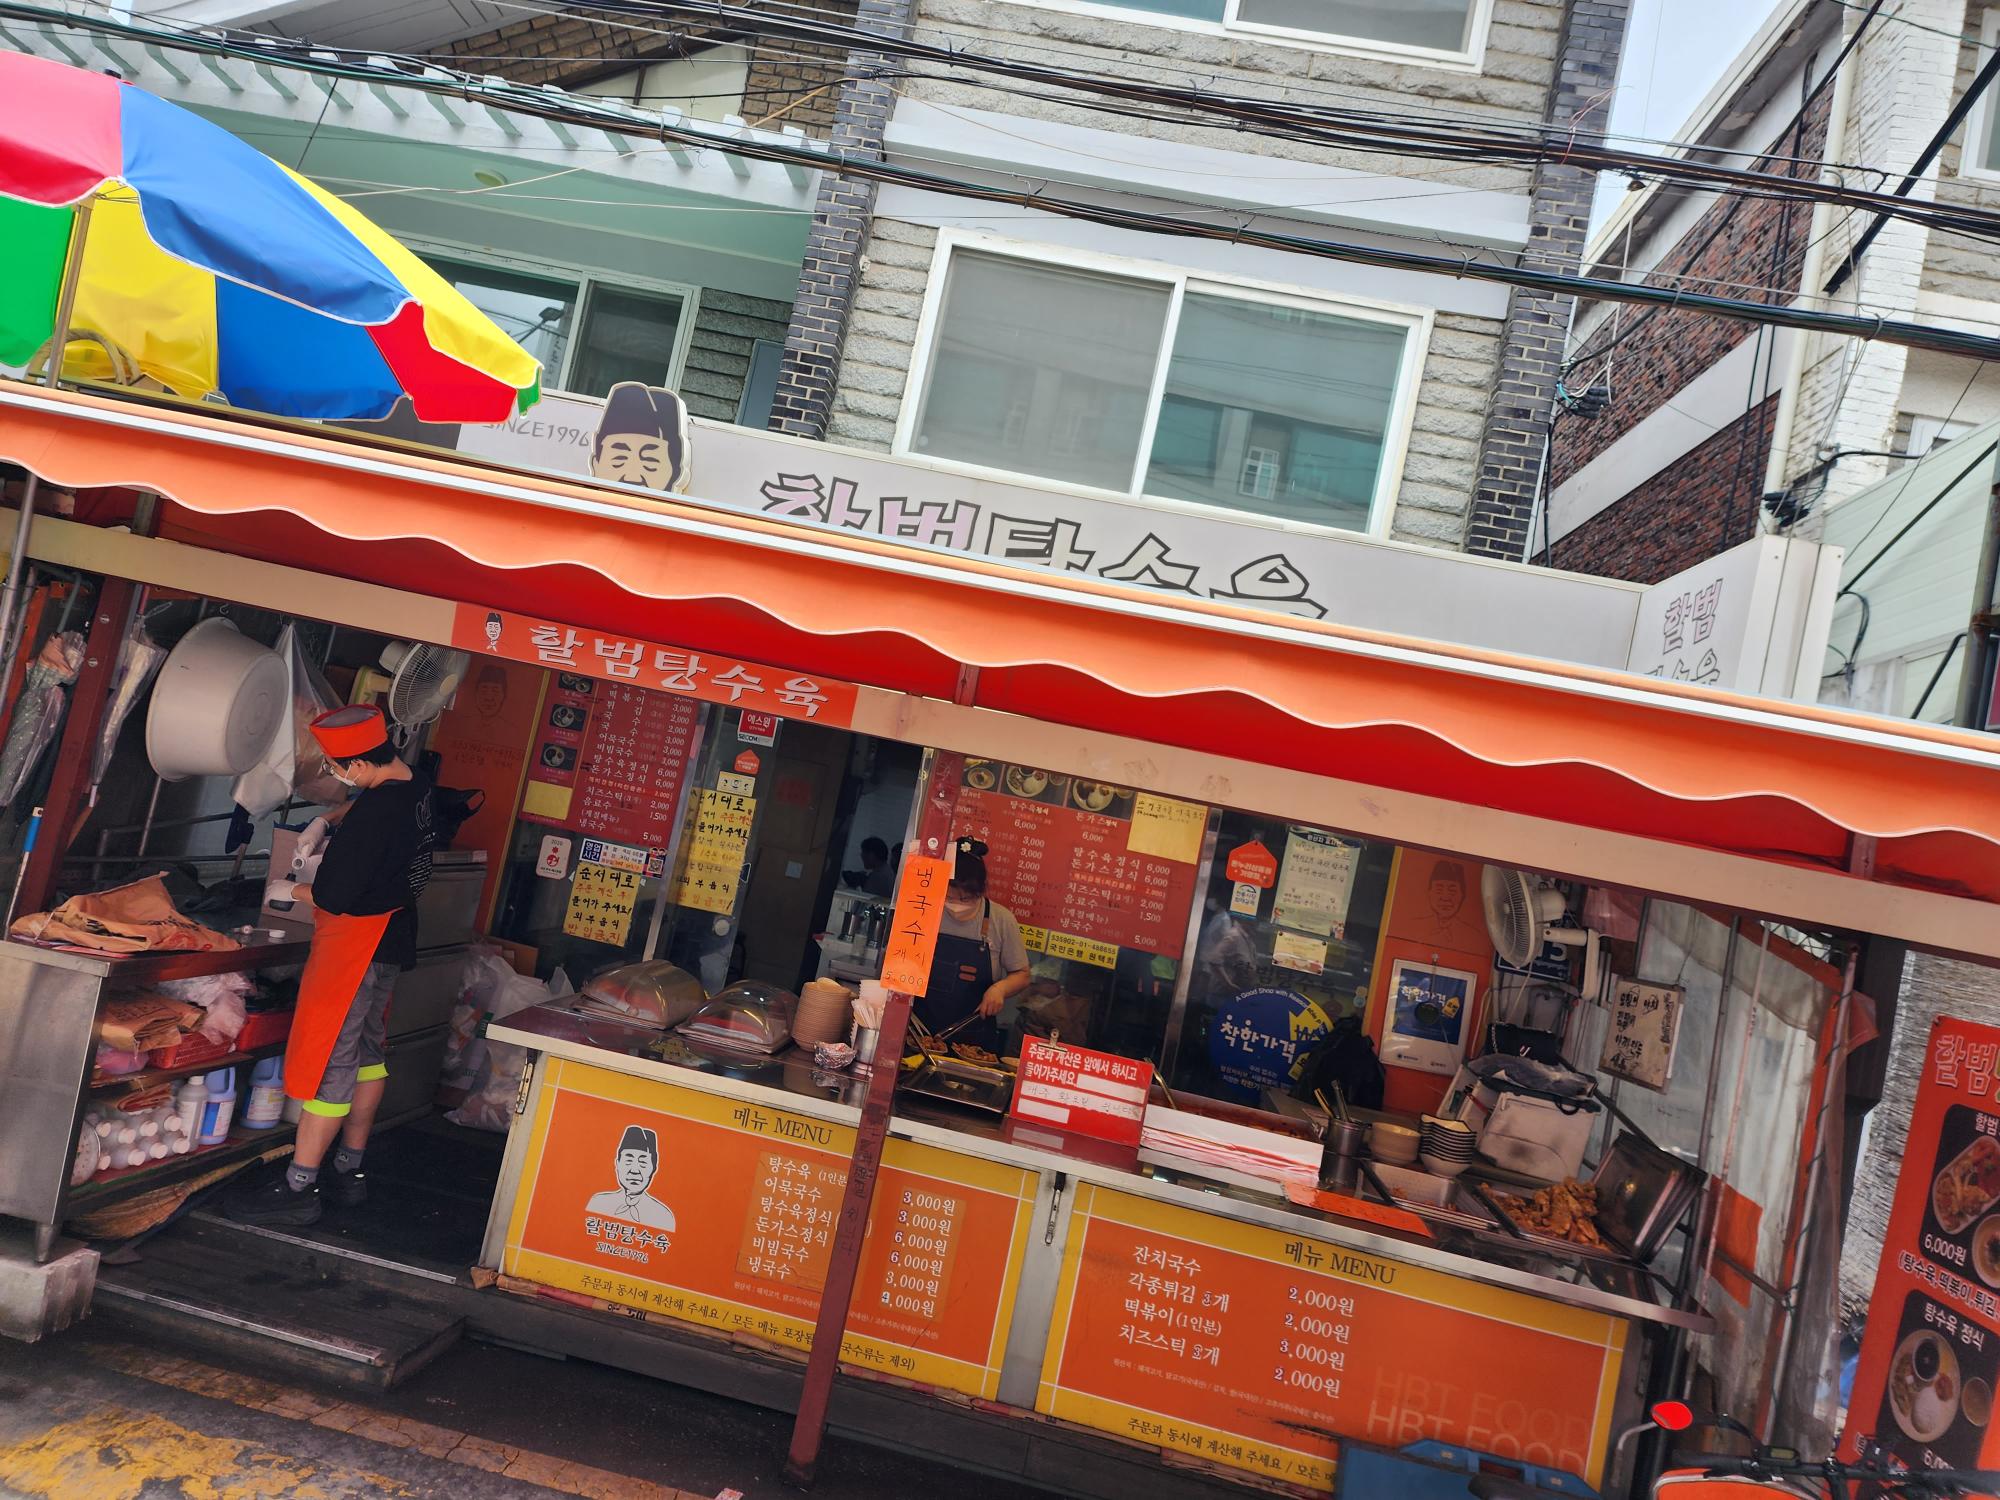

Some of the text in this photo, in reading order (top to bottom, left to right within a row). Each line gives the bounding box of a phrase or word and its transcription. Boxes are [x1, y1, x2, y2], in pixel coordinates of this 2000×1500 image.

[1662, 577, 1724, 655] 할범
[530, 625, 829, 718] 할범탕수육
[746, 712, 772, 729] 에스원
[585, 841, 602, 853] 영업
[1014, 819, 1037, 832] 6,000
[1082, 830, 1105, 843] 6,000
[1023, 836, 1046, 848] 3,000
[582, 850, 601, 862] 시간
[1020, 847, 1043, 860] 3,000
[1146, 863, 1170, 876] 6,000
[579, 867, 635, 889] 순서대로
[1144, 875, 1168, 888] 6,000
[900, 866, 933, 946] 냉국수
[1140, 898, 1164, 911] 2,000
[1059, 915, 1094, 931] 냉국수
[1220, 1013, 1297, 1065] 착한가격
[1027, 1042, 1054, 1062] 주문과
[1084, 1056, 1110, 1076] 앞에서
[1111, 1062, 1138, 1081] 하시고
[733, 1107, 833, 1145] 메뉴 MENU
[769, 1157, 812, 1181] 탕수육
[764, 1176, 822, 1203] 어묵국수
[585, 1215, 673, 1254] 할범탕수육
[755, 1215, 828, 1248] 돈가스정식
[752, 1236, 810, 1264] 비빔국수
[1131, 1245, 1202, 1277] 잔치국수
[1284, 1240, 1397, 1284] 메뉴 MENU
[1923, 1232, 1968, 1268] 6,000원
[747, 1255, 791, 1281] 냉국수
[1127, 1271, 1196, 1304] 각종튀김
[580, 1274, 614, 1293] 주문과
[615, 1283, 649, 1302] 동시에
[652, 1292, 685, 1311] 계산해
[687, 1302, 720, 1320] 주세요
[731, 1314, 754, 1330] 모든
[757, 1321, 780, 1336] 메뉴
[890, 1353, 917, 1373] 제외)
[1924, 1301, 1985, 1352] 탕수육 정식
[1118, 1323, 1186, 1358] 치즈스틱
[1127, 1417, 1164, 1438] 주문과
[1166, 1427, 1203, 1449] 동시에
[1206, 1439, 1243, 1461] 계산해
[1246, 1450, 1282, 1471] 주세요
[1295, 1463, 1320, 1482] 모든
